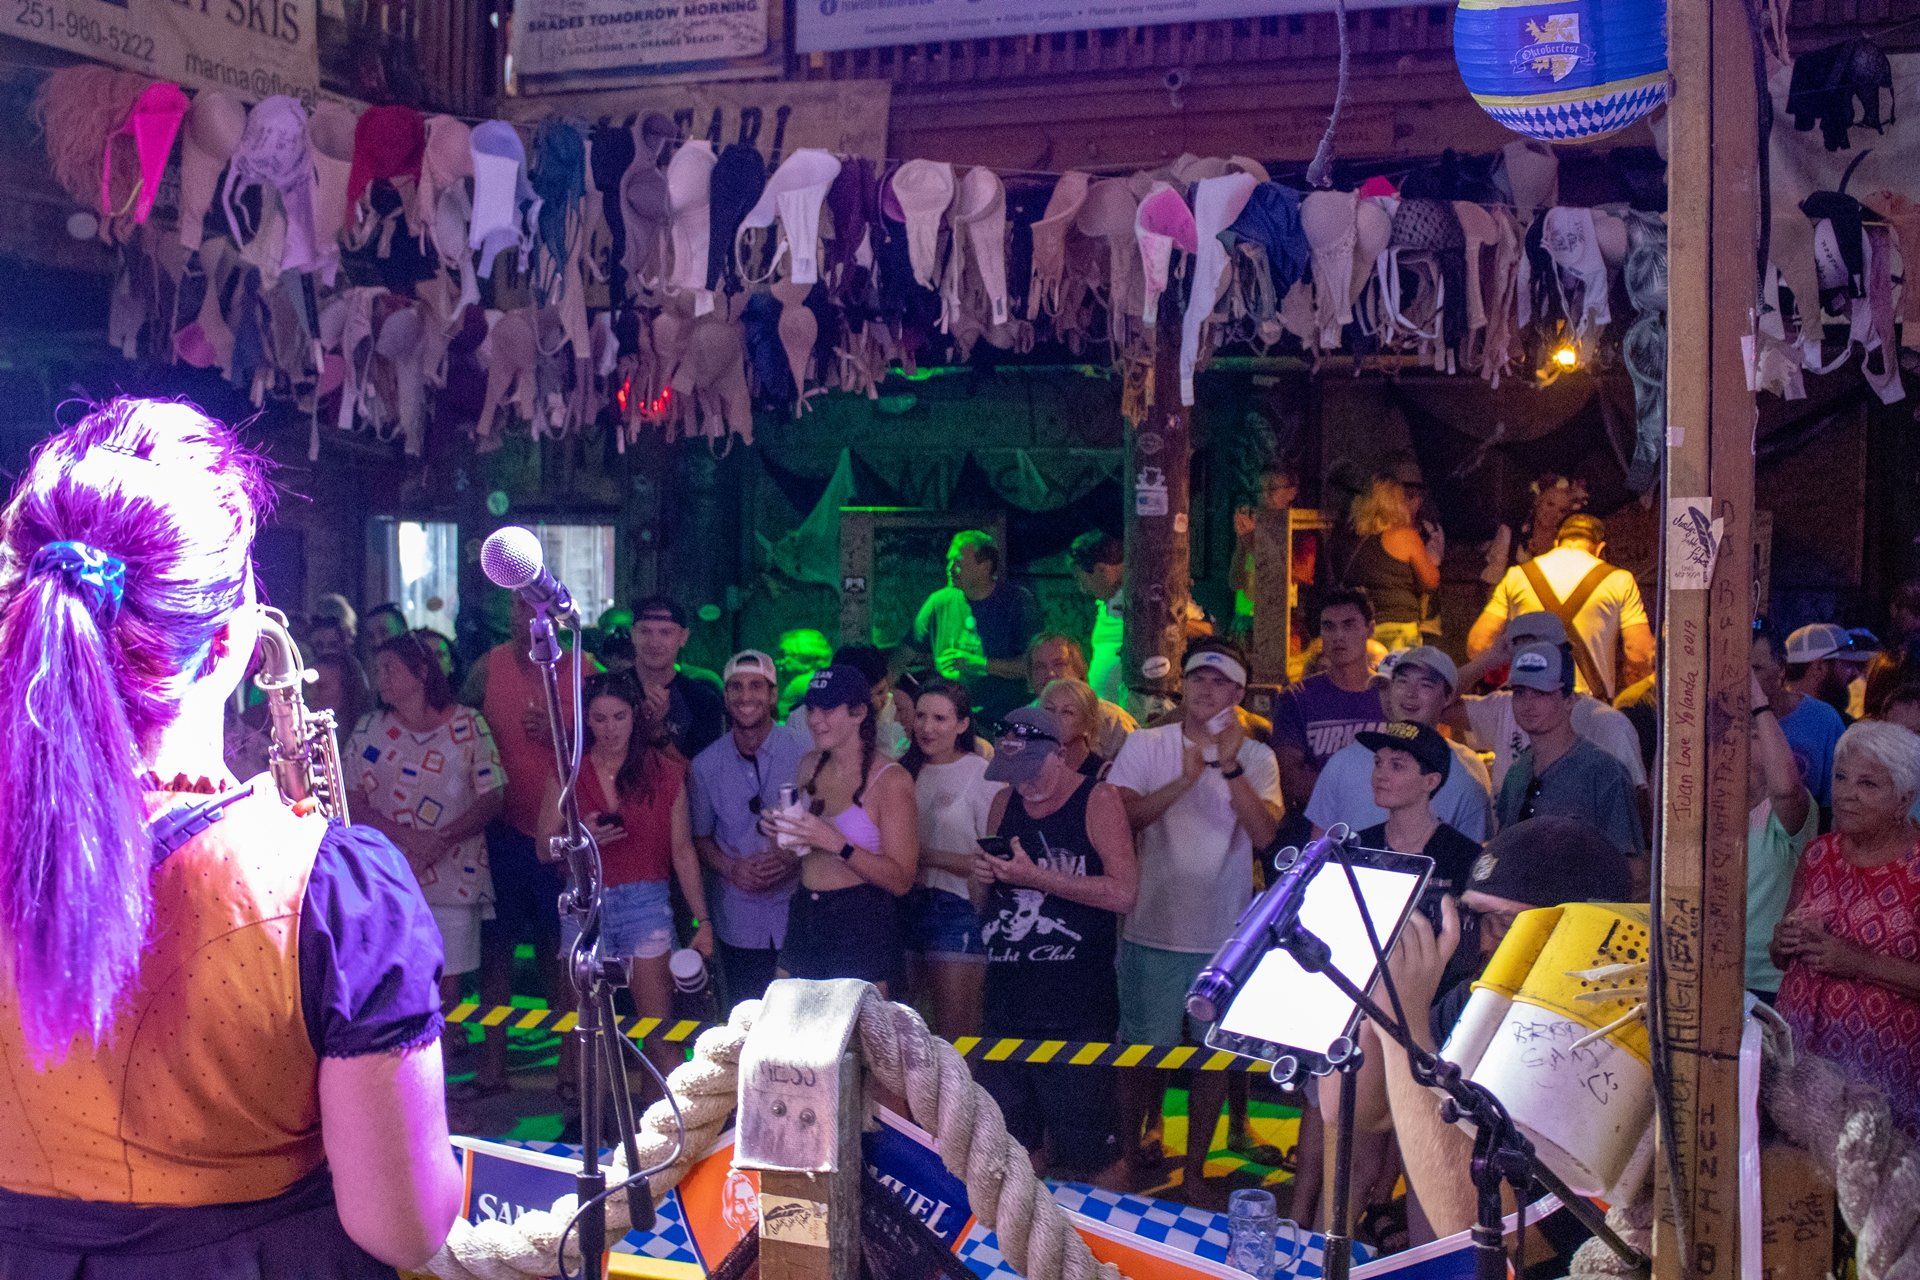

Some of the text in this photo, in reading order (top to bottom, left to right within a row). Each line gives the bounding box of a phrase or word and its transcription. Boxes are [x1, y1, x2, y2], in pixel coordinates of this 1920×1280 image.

[588, 6, 680, 27] TOMORROW
[683, 0, 759, 17] MORNING
[1521, 43, 1579, 60] Oktoberfest
[1676, 736, 1692, 769] Love
[1027, 944, 1076, 962] Club
